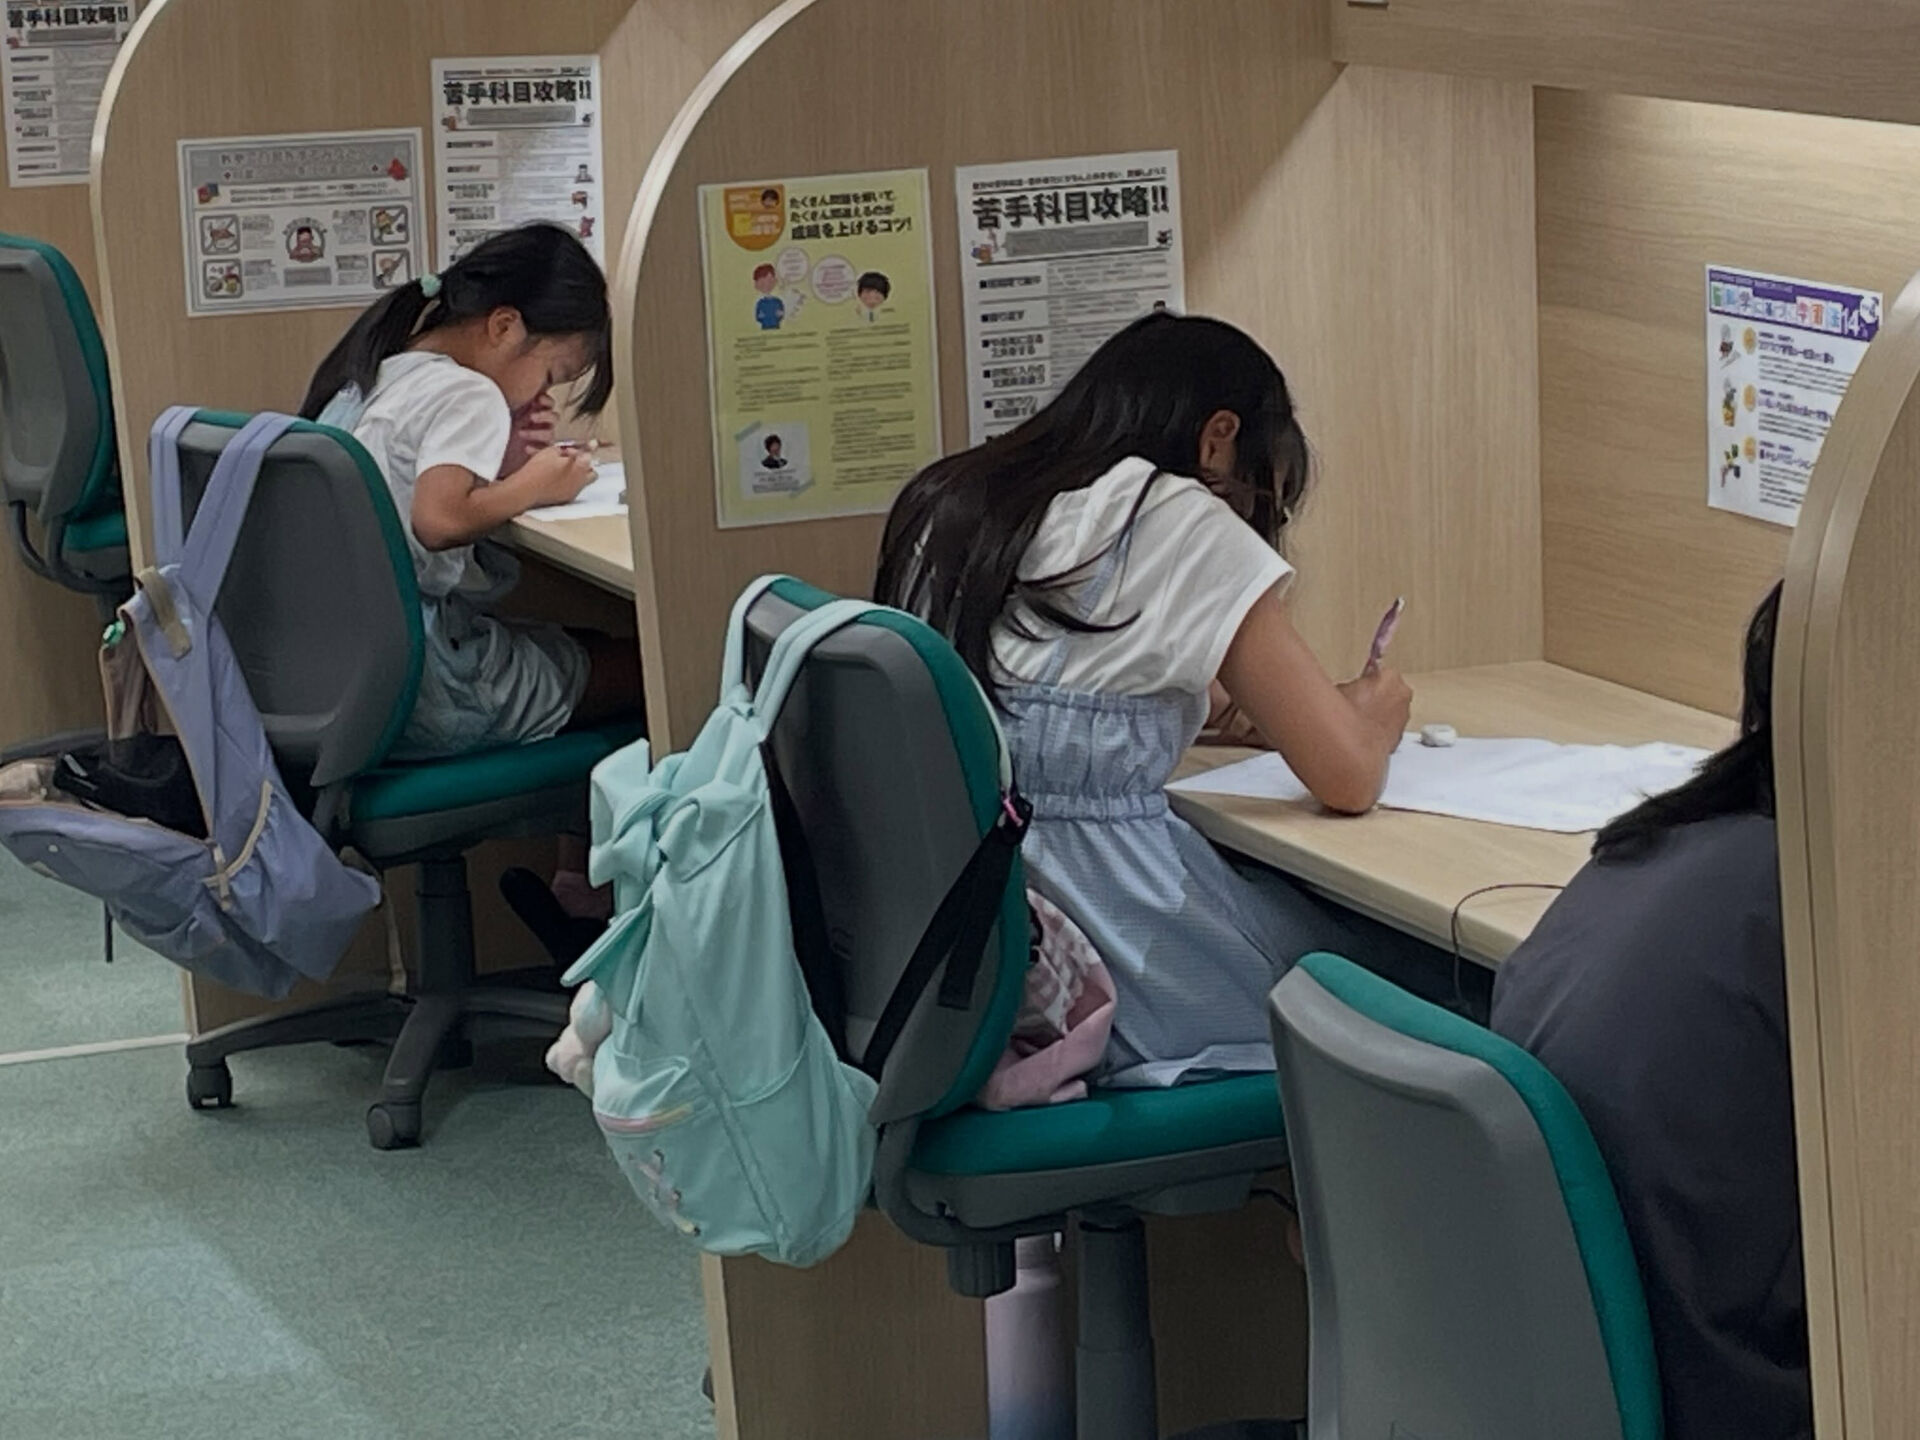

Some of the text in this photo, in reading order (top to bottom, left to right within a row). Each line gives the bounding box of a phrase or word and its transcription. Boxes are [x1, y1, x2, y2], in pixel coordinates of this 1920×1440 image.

[972, 185, 1169, 230] 苦手科目攻略!!
